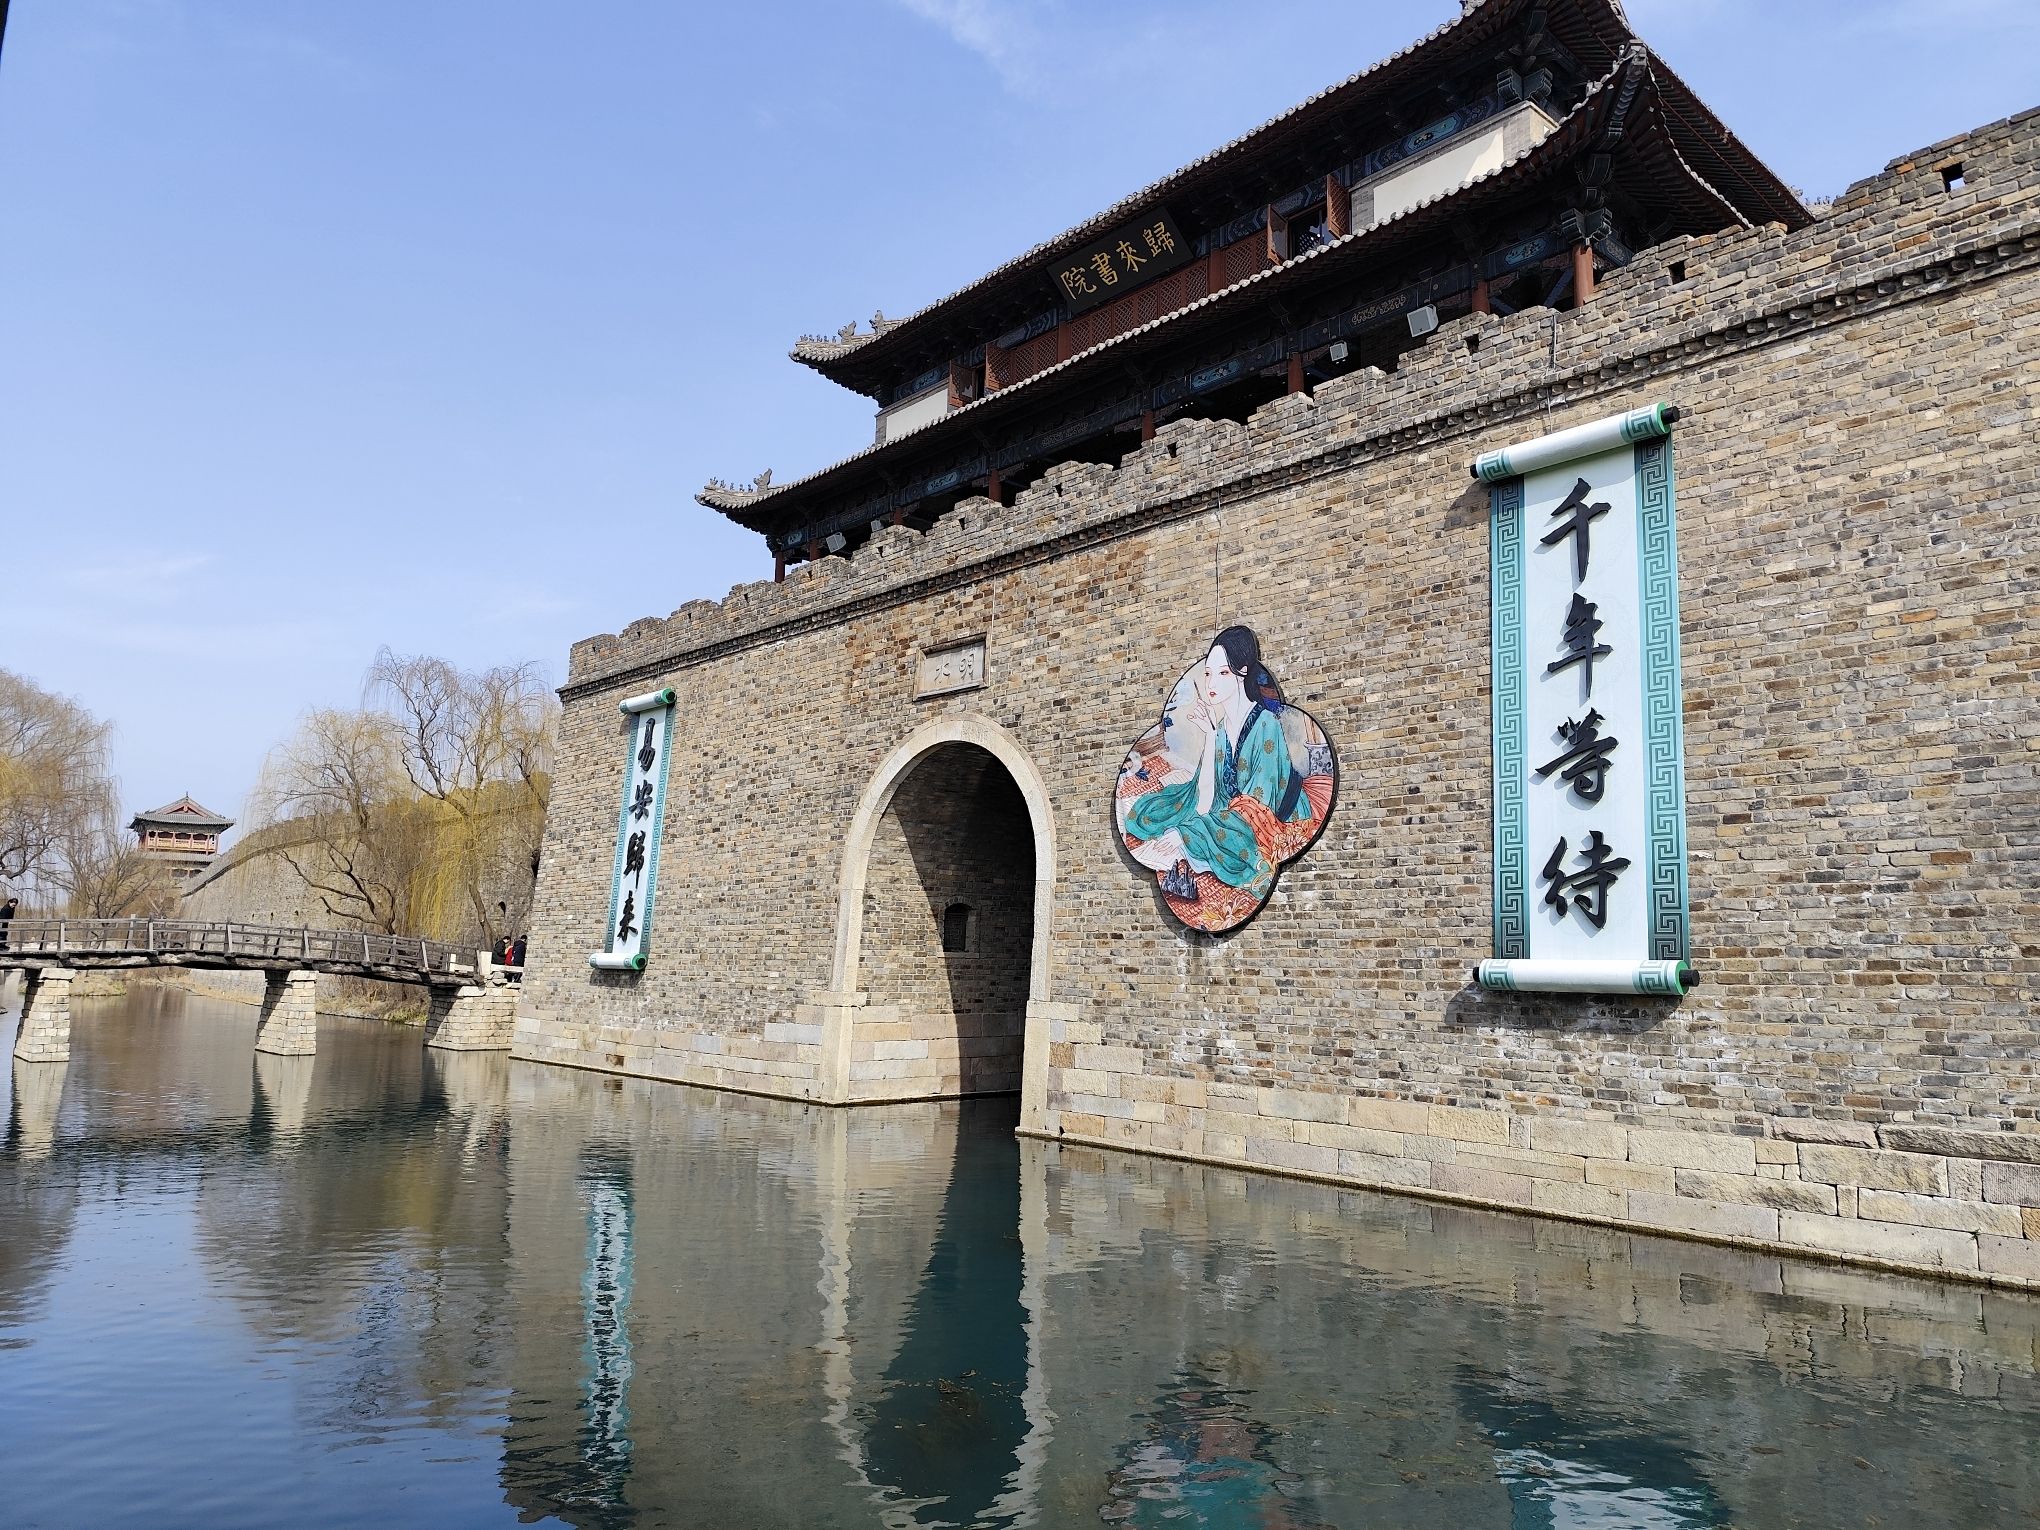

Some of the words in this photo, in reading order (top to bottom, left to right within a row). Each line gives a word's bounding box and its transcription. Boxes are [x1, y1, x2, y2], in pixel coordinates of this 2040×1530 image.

[1060, 221, 1175, 300] 歸來書院
[1535, 477, 1631, 930] 千年等待
